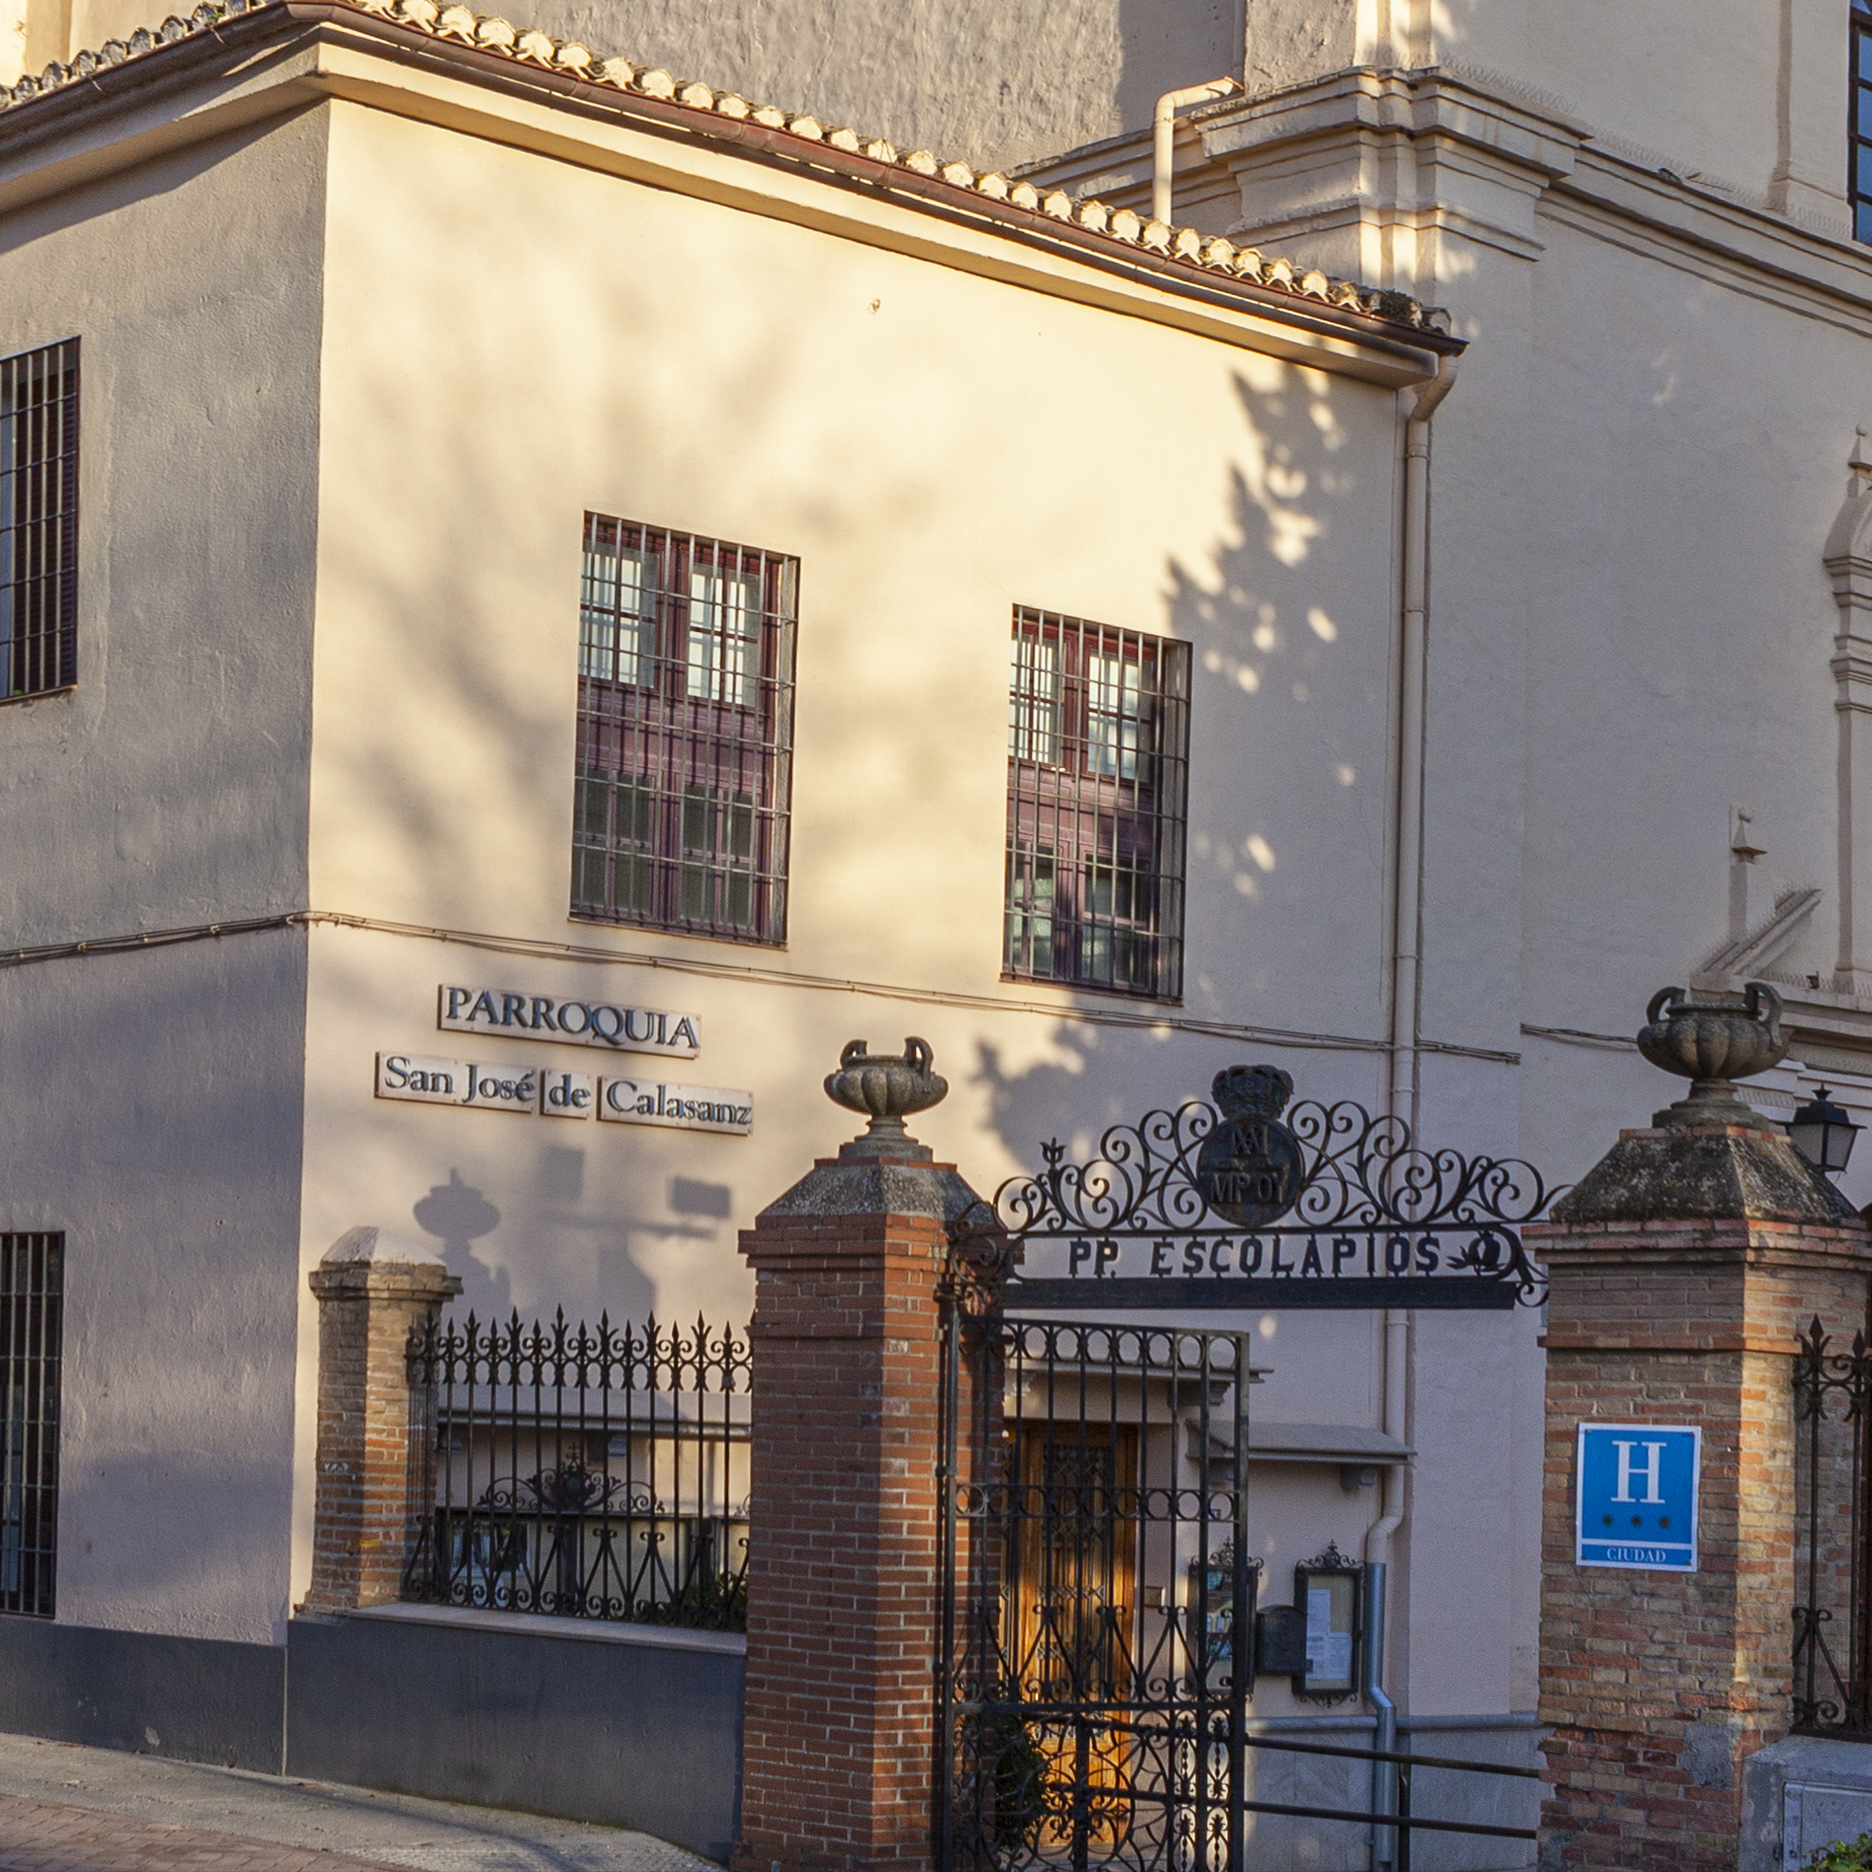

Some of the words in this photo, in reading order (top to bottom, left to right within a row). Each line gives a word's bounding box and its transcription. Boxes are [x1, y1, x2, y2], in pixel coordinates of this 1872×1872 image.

[445, 986, 699, 1048] PARROQUIA
[384, 1056, 455, 1095] San
[461, 1063, 536, 1104] José
[548, 1074, 591, 1109] de
[605, 1080, 753, 1126] Calasanz
[1150, 1234, 1441, 1277] ESCOLAPIOS
[1610, 1440, 1668, 1504] H
[1606, 1547, 1667, 1563] CIUDAD
